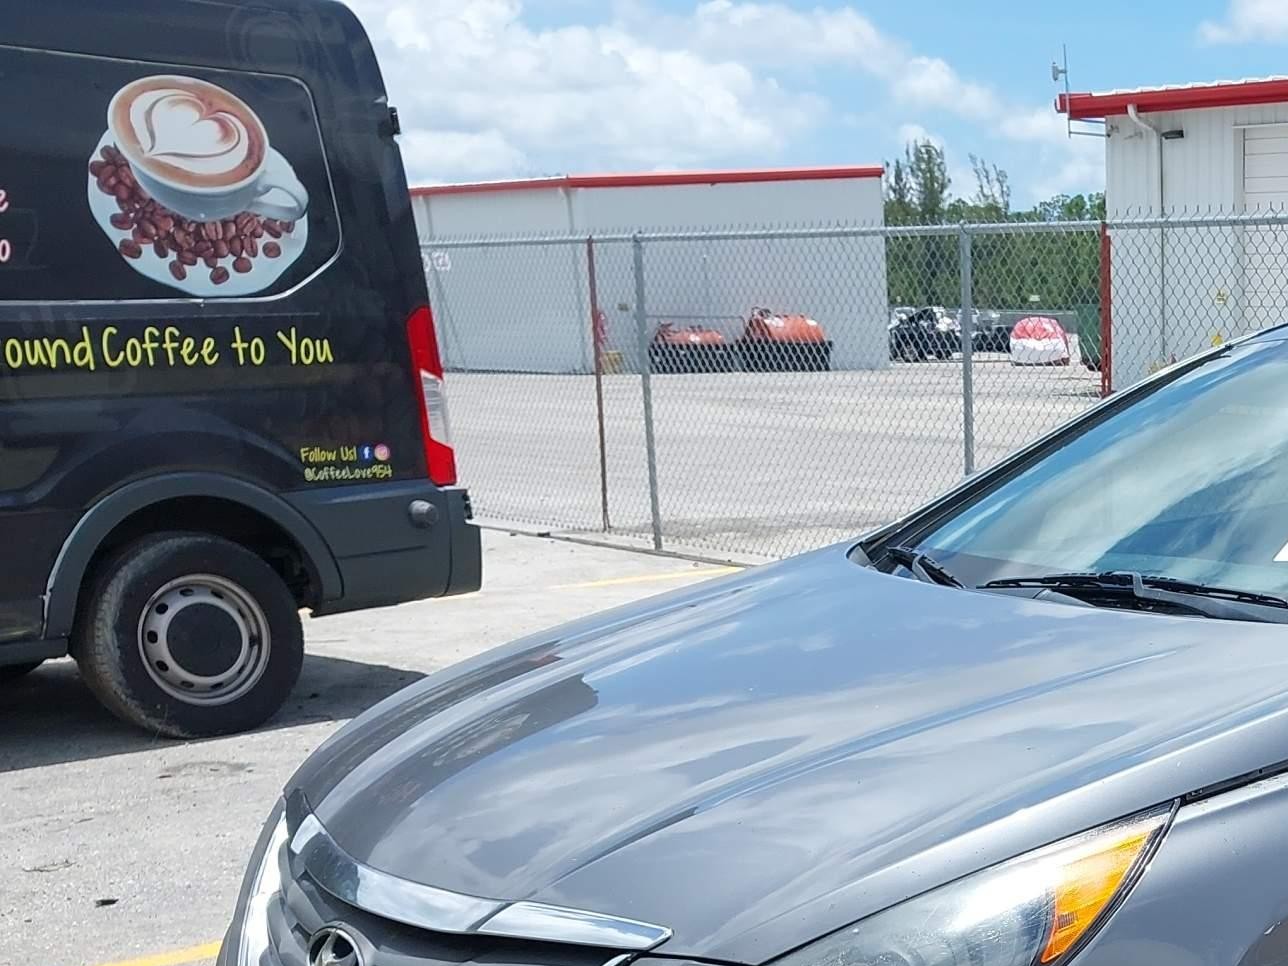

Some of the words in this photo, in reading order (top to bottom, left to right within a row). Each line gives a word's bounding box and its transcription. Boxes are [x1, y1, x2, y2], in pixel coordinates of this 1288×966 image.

[3, 326, 96, 371] ound
[101, 325, 220, 368] Coffee
[230, 325, 266, 367] to
[276, 326, 335, 365] You
[300, 446, 338, 463] Follow
